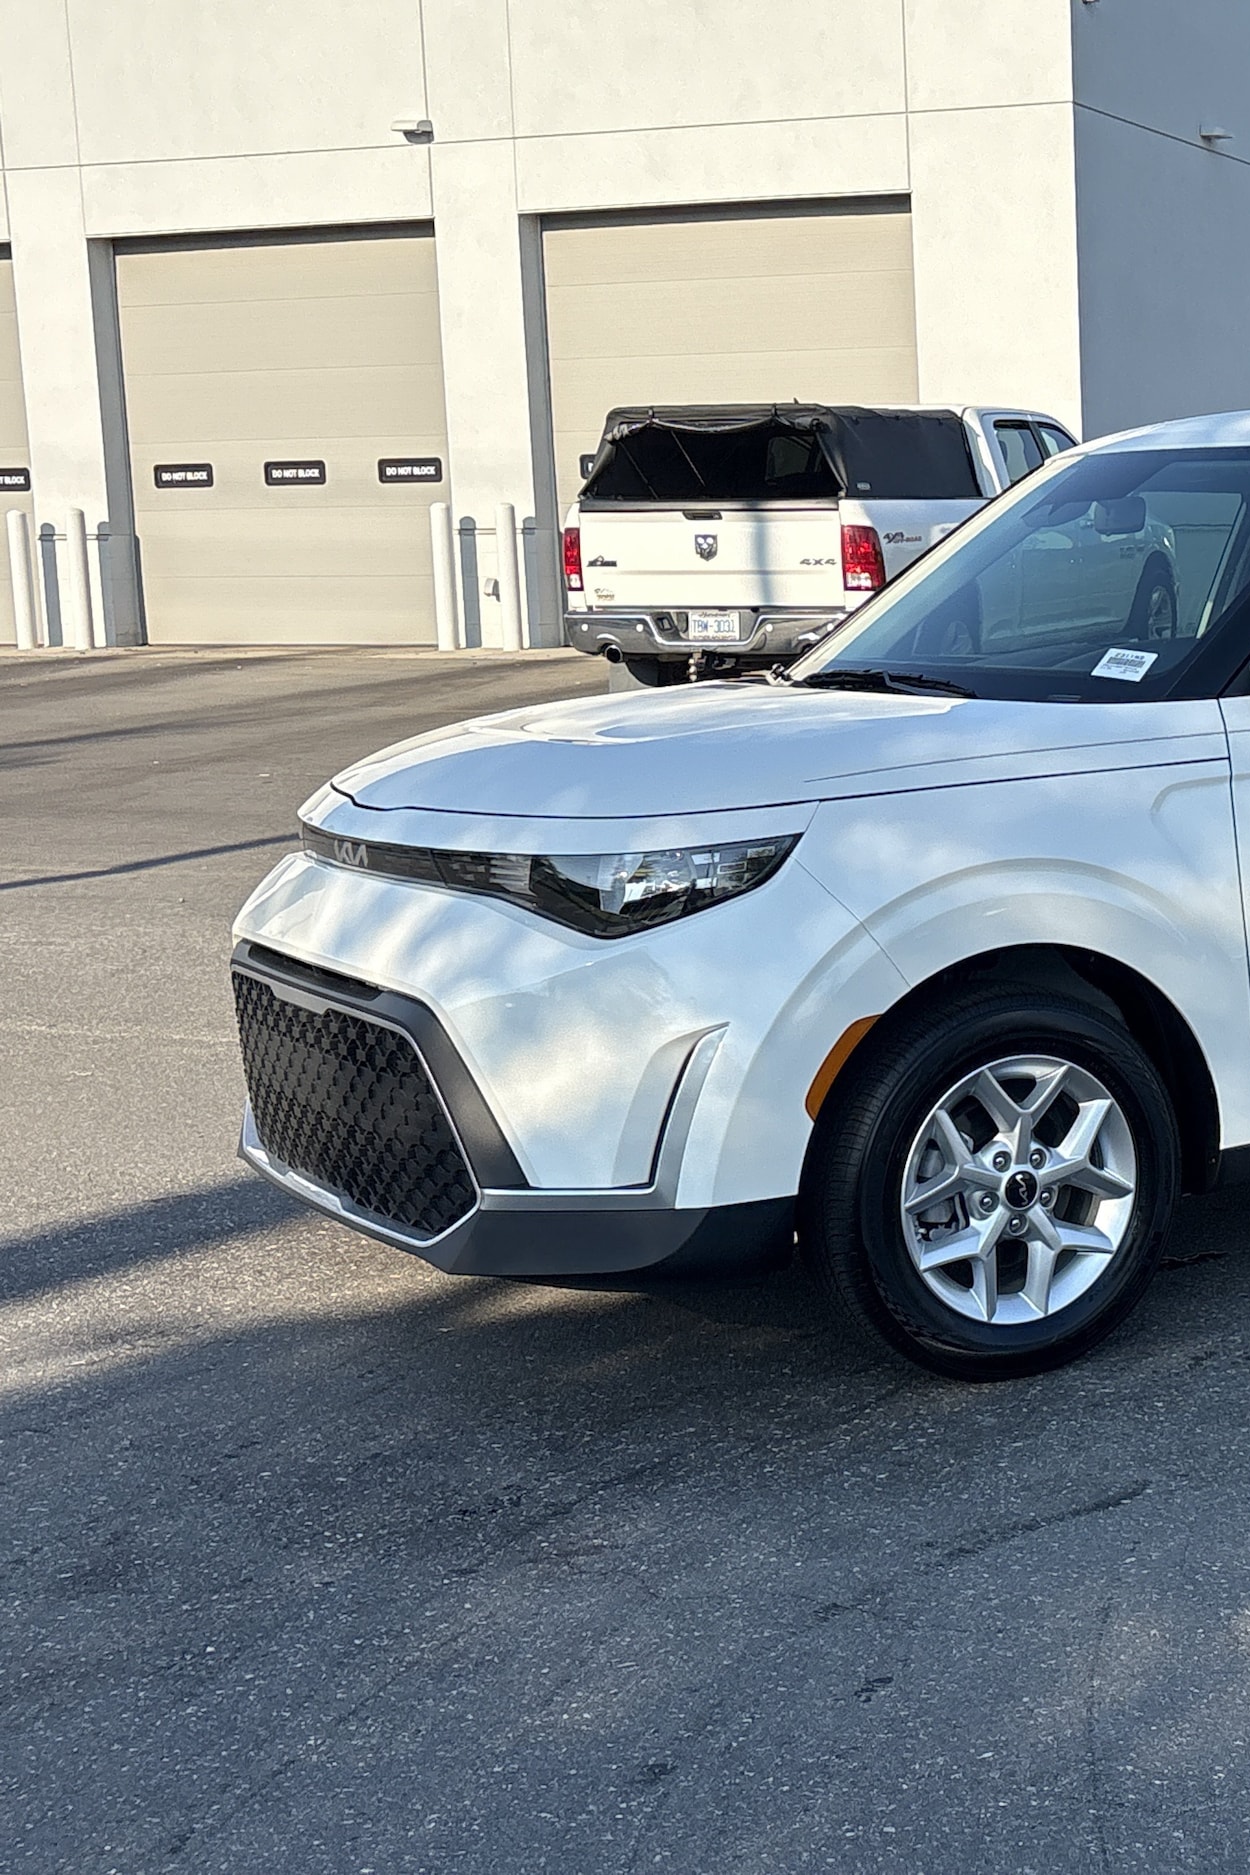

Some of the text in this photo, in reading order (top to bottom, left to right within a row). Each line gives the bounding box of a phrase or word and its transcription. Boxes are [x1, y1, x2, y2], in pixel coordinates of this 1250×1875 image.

[161, 471, 208, 481] DO NOT BLOCK
[271, 468, 320, 479] DO NOT BLOCK
[385, 465, 436, 476] DO NOT BLOCK
[4, 475, 26, 485] BLOCK
[333, 839, 369, 868] KIA
